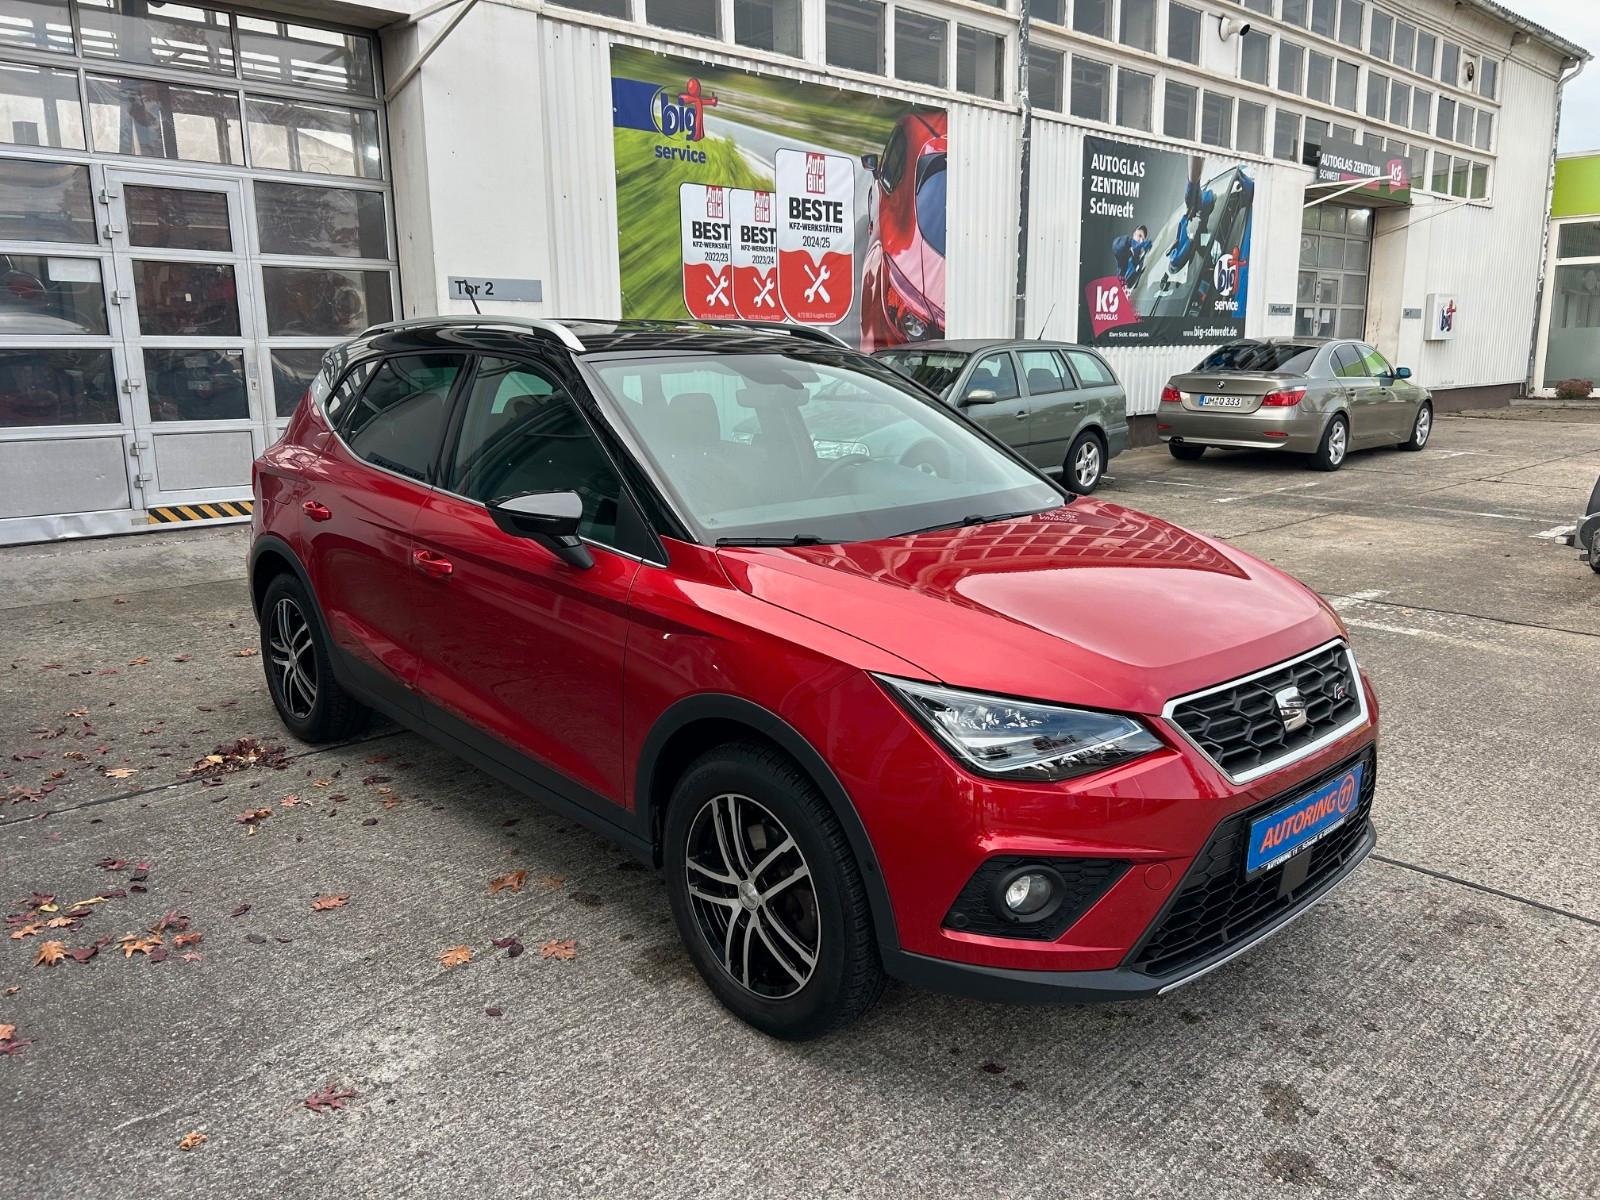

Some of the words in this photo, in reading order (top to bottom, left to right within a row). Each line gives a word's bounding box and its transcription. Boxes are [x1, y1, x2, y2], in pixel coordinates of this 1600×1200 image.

[655, 144, 707, 164] service
[1090, 153, 1145, 178] AUTOGLAS
[1320, 153, 1353, 172] AUTOGLAS
[1353, 160, 1381, 177] ZENTRUM
[1319, 168, 1341, 182] SCHWEDT
[1090, 175, 1140, 198] ZENTRUM
[788, 197, 843, 224] BESTE
[1089, 197, 1134, 219] Schwedt
[788, 222, 843, 234] KFZ-WERKSTÄTTEN
[802, 235, 831, 249] 2024/25
[705, 251, 729, 263] 2022/23
[752, 254, 775, 265] 2023/24
[455, 280, 480, 295] Tor
[484, 281, 494, 296] 2
[1214, 298, 1239, 311] service
[1260, 790, 1338, 854] AUTORING
